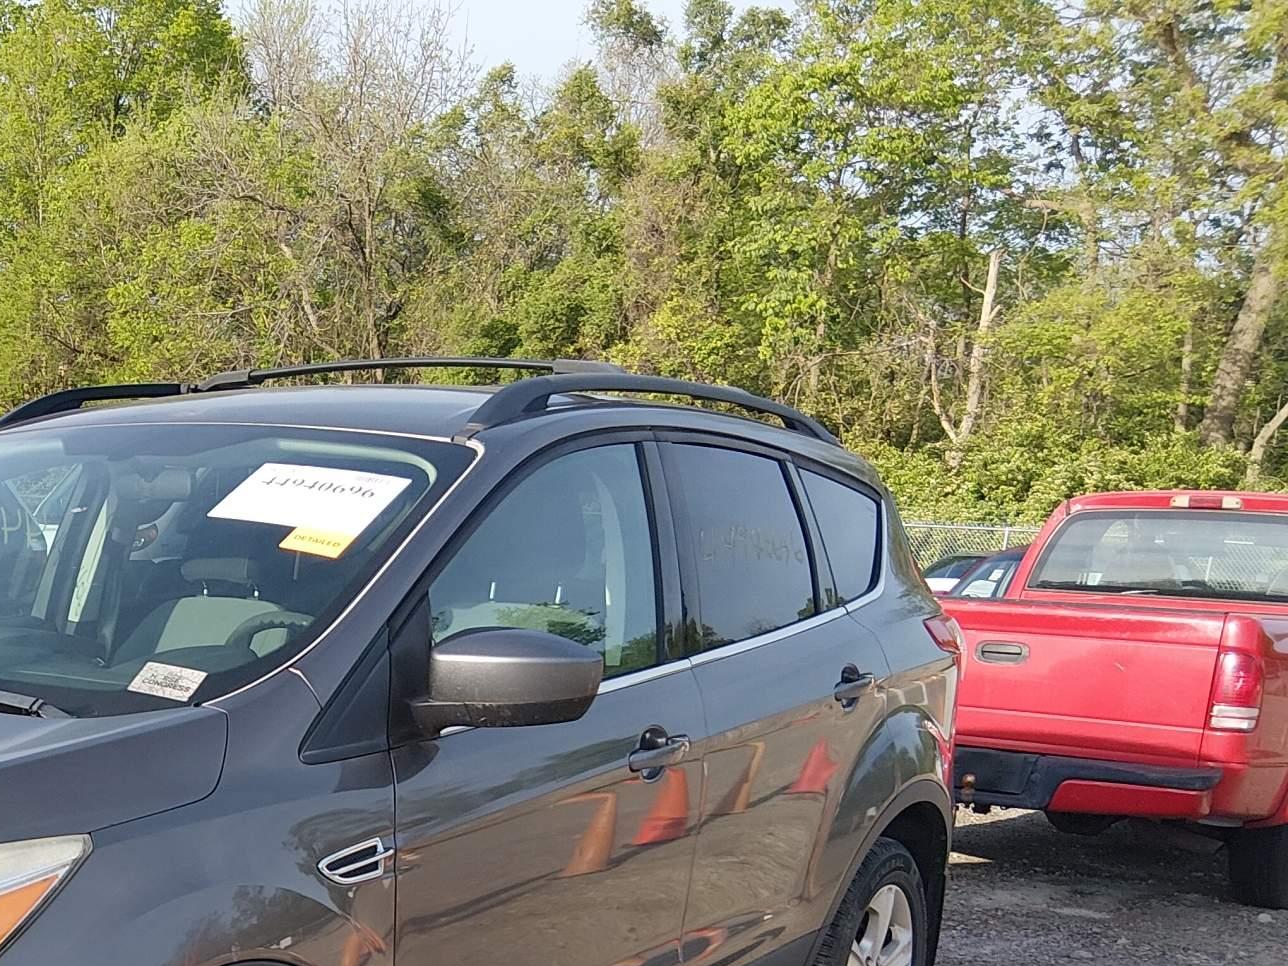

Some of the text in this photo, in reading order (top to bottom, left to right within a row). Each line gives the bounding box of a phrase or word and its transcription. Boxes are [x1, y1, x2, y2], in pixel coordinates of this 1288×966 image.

[262, 476, 375, 498] 44940696
[293, 533, 342, 548] DETAILED
[142, 677, 192, 693] CONGRESS
